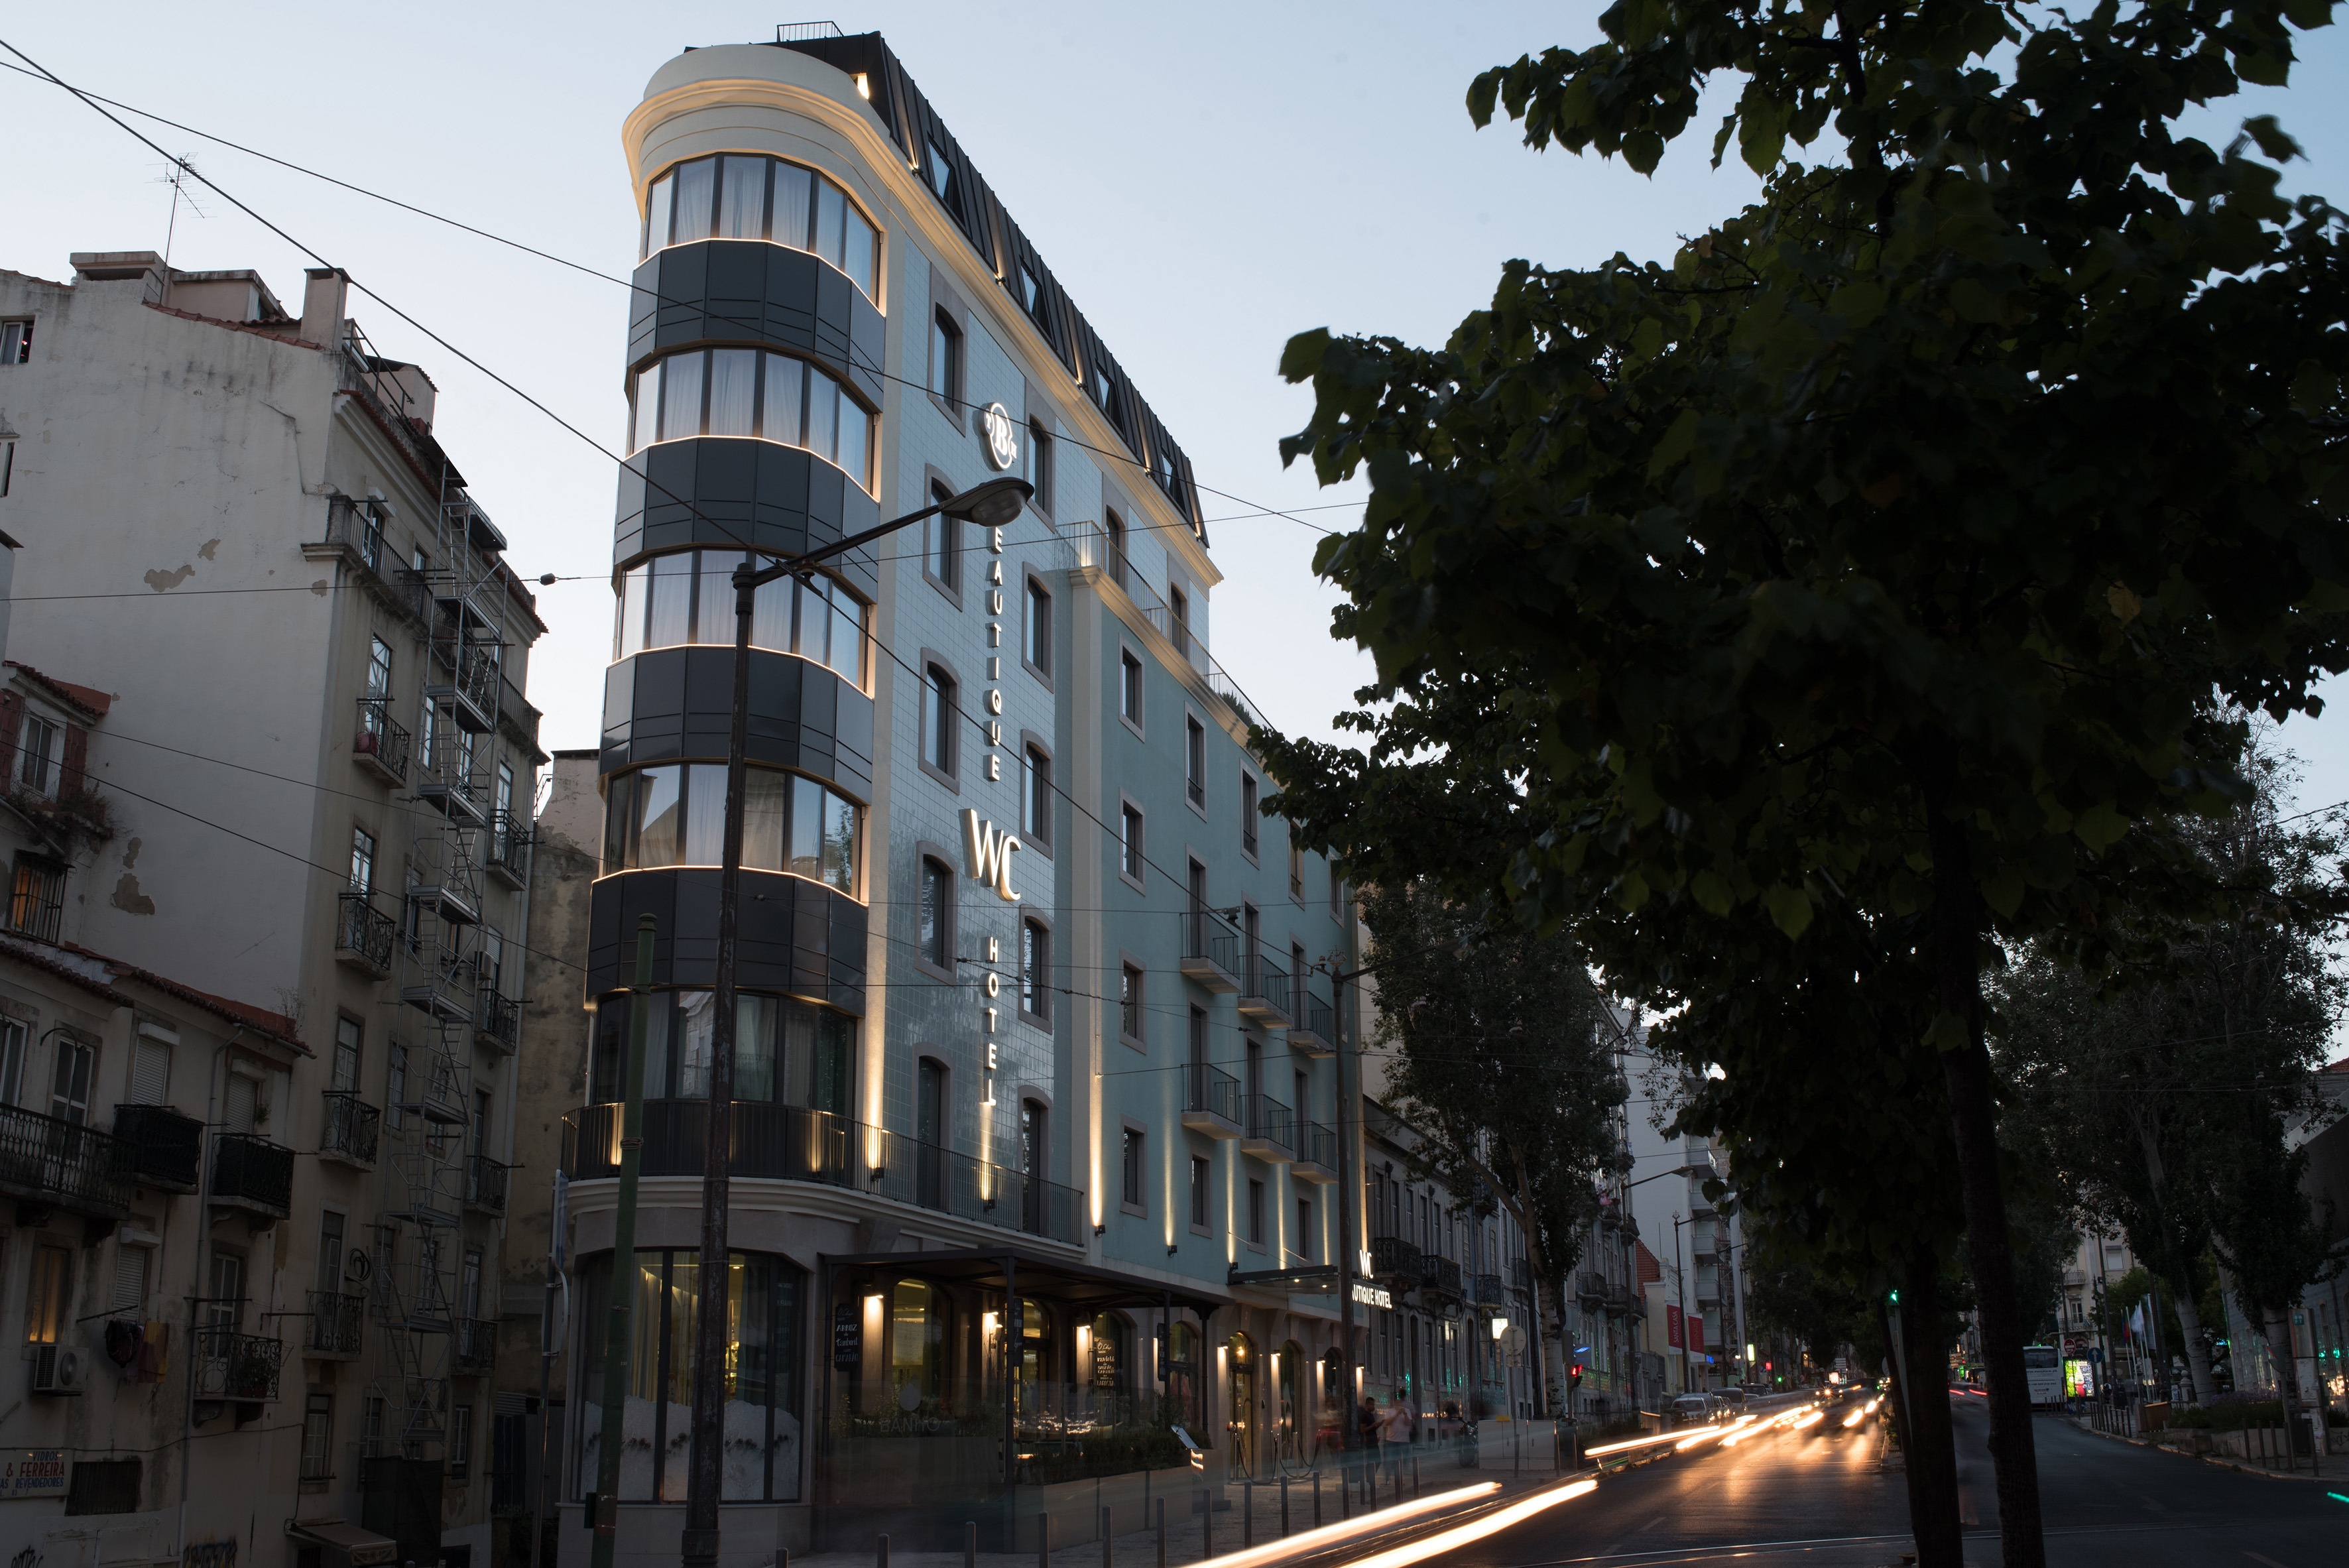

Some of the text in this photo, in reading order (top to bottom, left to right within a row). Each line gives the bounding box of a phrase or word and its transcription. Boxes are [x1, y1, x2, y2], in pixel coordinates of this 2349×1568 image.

[991, 526, 1002, 782] EAUTIQUE
[965, 808, 1021, 901] WC
[987, 937, 997, 1106] HOTEL
[1359, 1250, 1374, 1280] WC
[1353, 1284, 1392, 1309] UTIQUE HOTEL
[880, 1416, 940, 1432] BANHO
[33, 1451, 58, 1461] VIDROS
[7, 1461, 64, 1477] & FERREIRA
[0, 1477, 64, 1489] AS REVENDEDORES
